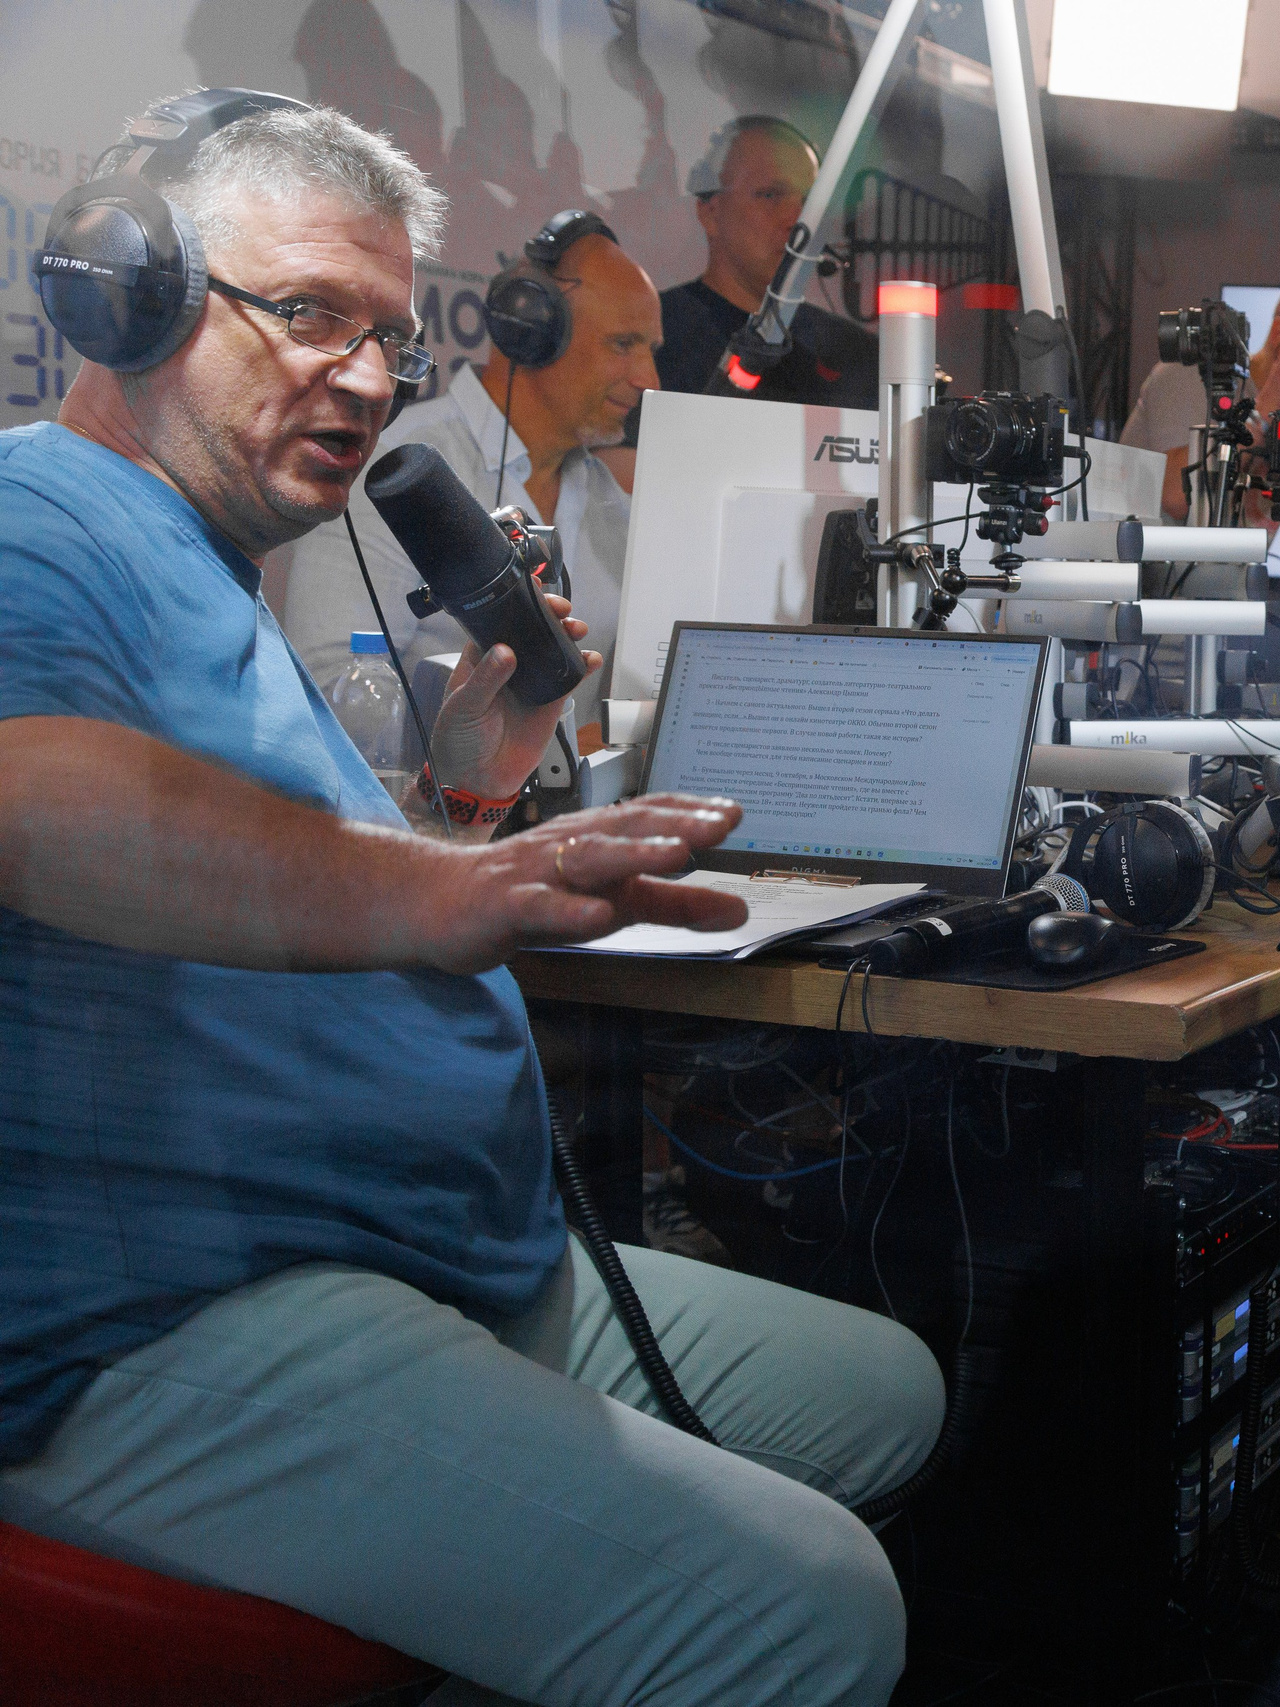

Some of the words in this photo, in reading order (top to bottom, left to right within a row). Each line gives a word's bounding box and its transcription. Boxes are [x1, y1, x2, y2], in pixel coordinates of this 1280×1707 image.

[43, 256, 53, 265] DT
[53, 257, 69, 268] 770
[70, 259, 89, 270] PRO
[813, 435, 879, 465] ASU
[1111, 731, 1147, 745] mika
[1120, 857, 1129, 876] PRO
[1123, 877, 1133, 894] 770
[1128, 895, 1136, 906] DT
